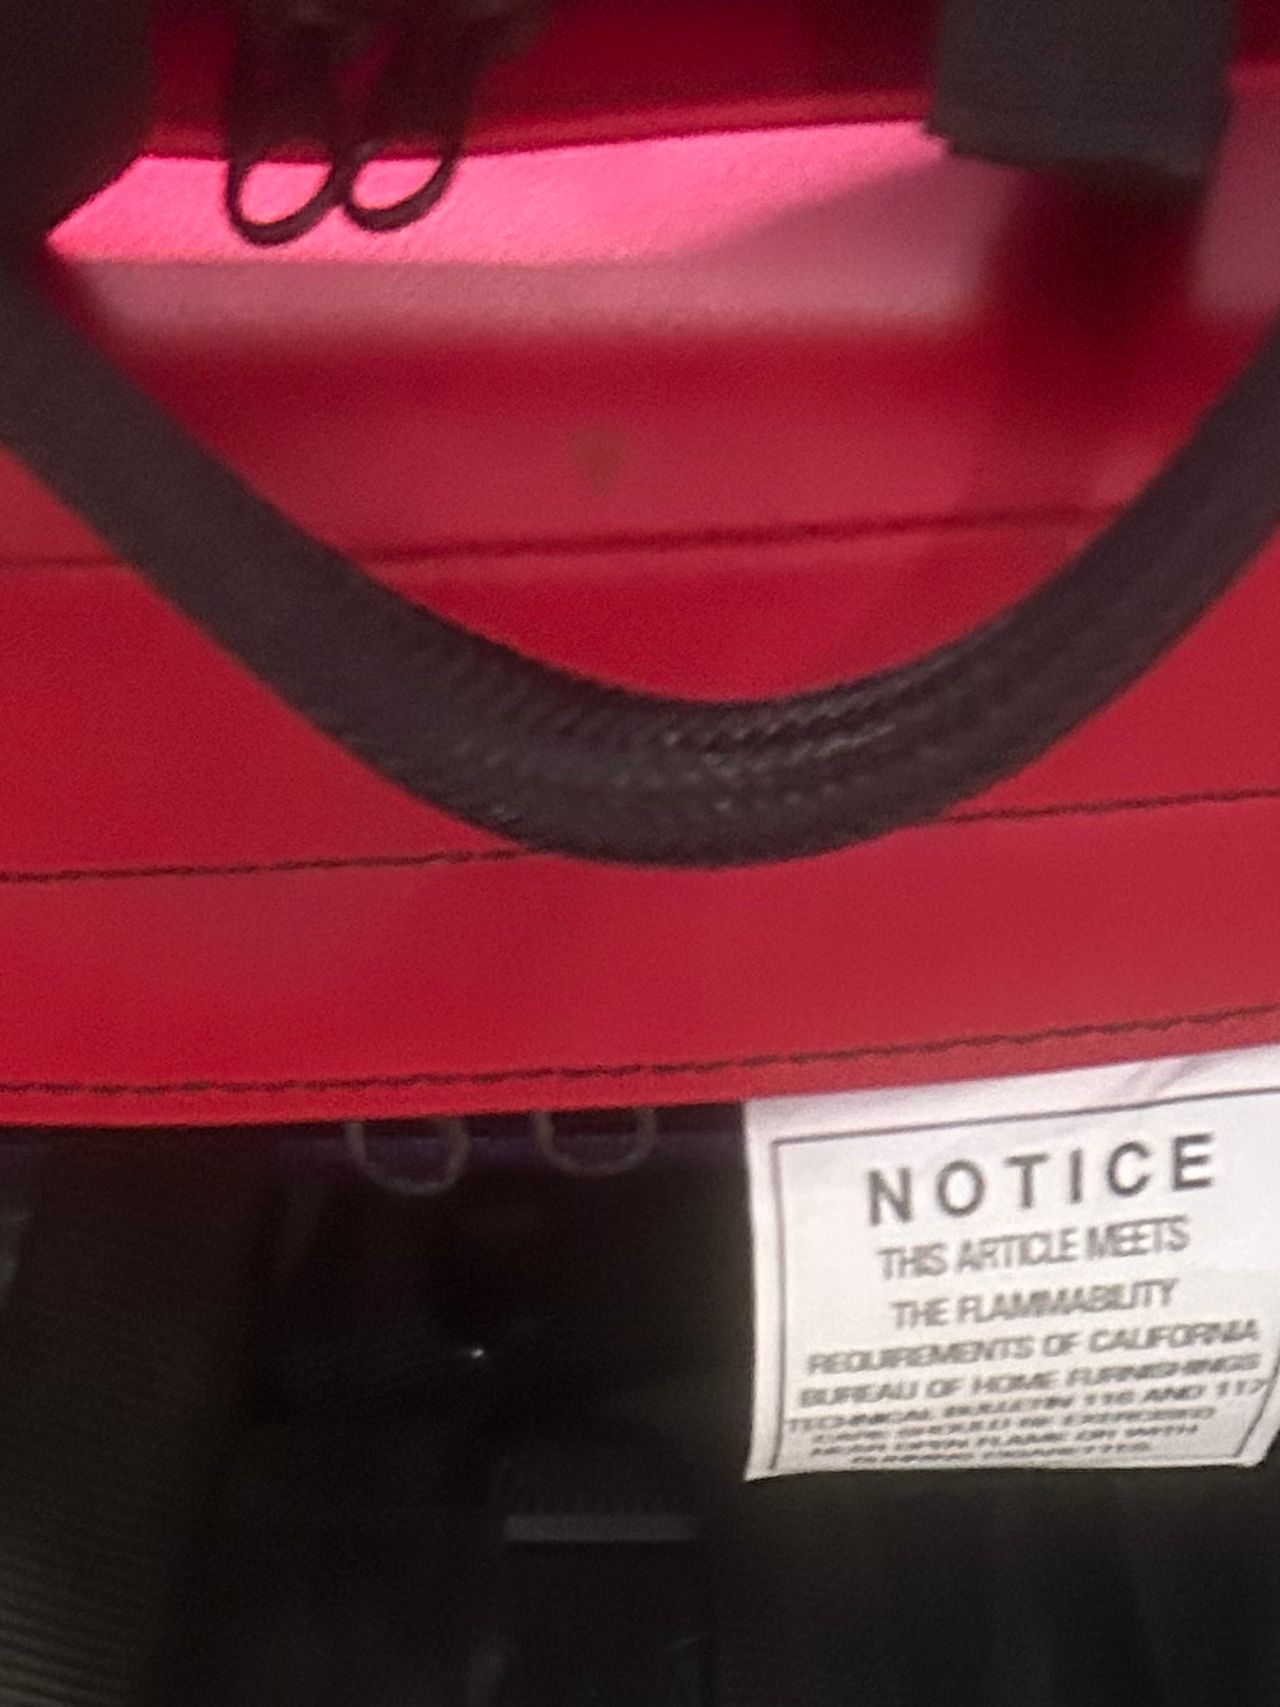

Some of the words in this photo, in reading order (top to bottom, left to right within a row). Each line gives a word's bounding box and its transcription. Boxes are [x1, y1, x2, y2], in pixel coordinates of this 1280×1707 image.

[868, 1132, 1214, 1227] NOTICE
[877, 1242, 948, 1280] THIS
[956, 1227, 1079, 1272] ARTICLE
[1085, 1214, 1190, 1260] MEETS
[891, 1298, 950, 1328] THE
[956, 1278, 1179, 1324] FLAMMABILITY
[807, 1335, 1035, 1376] REQUIREMENTS
[1042, 1331, 1080, 1357] OF
[1088, 1318, 1259, 1353] CALIFORNIA
[800, 1379, 919, 1408] BUREAU
[926, 1376, 964, 1399] OF
[971, 1369, 1060, 1395] HOME
[1066, 1352, 1262, 1387] FURNISHINGS
